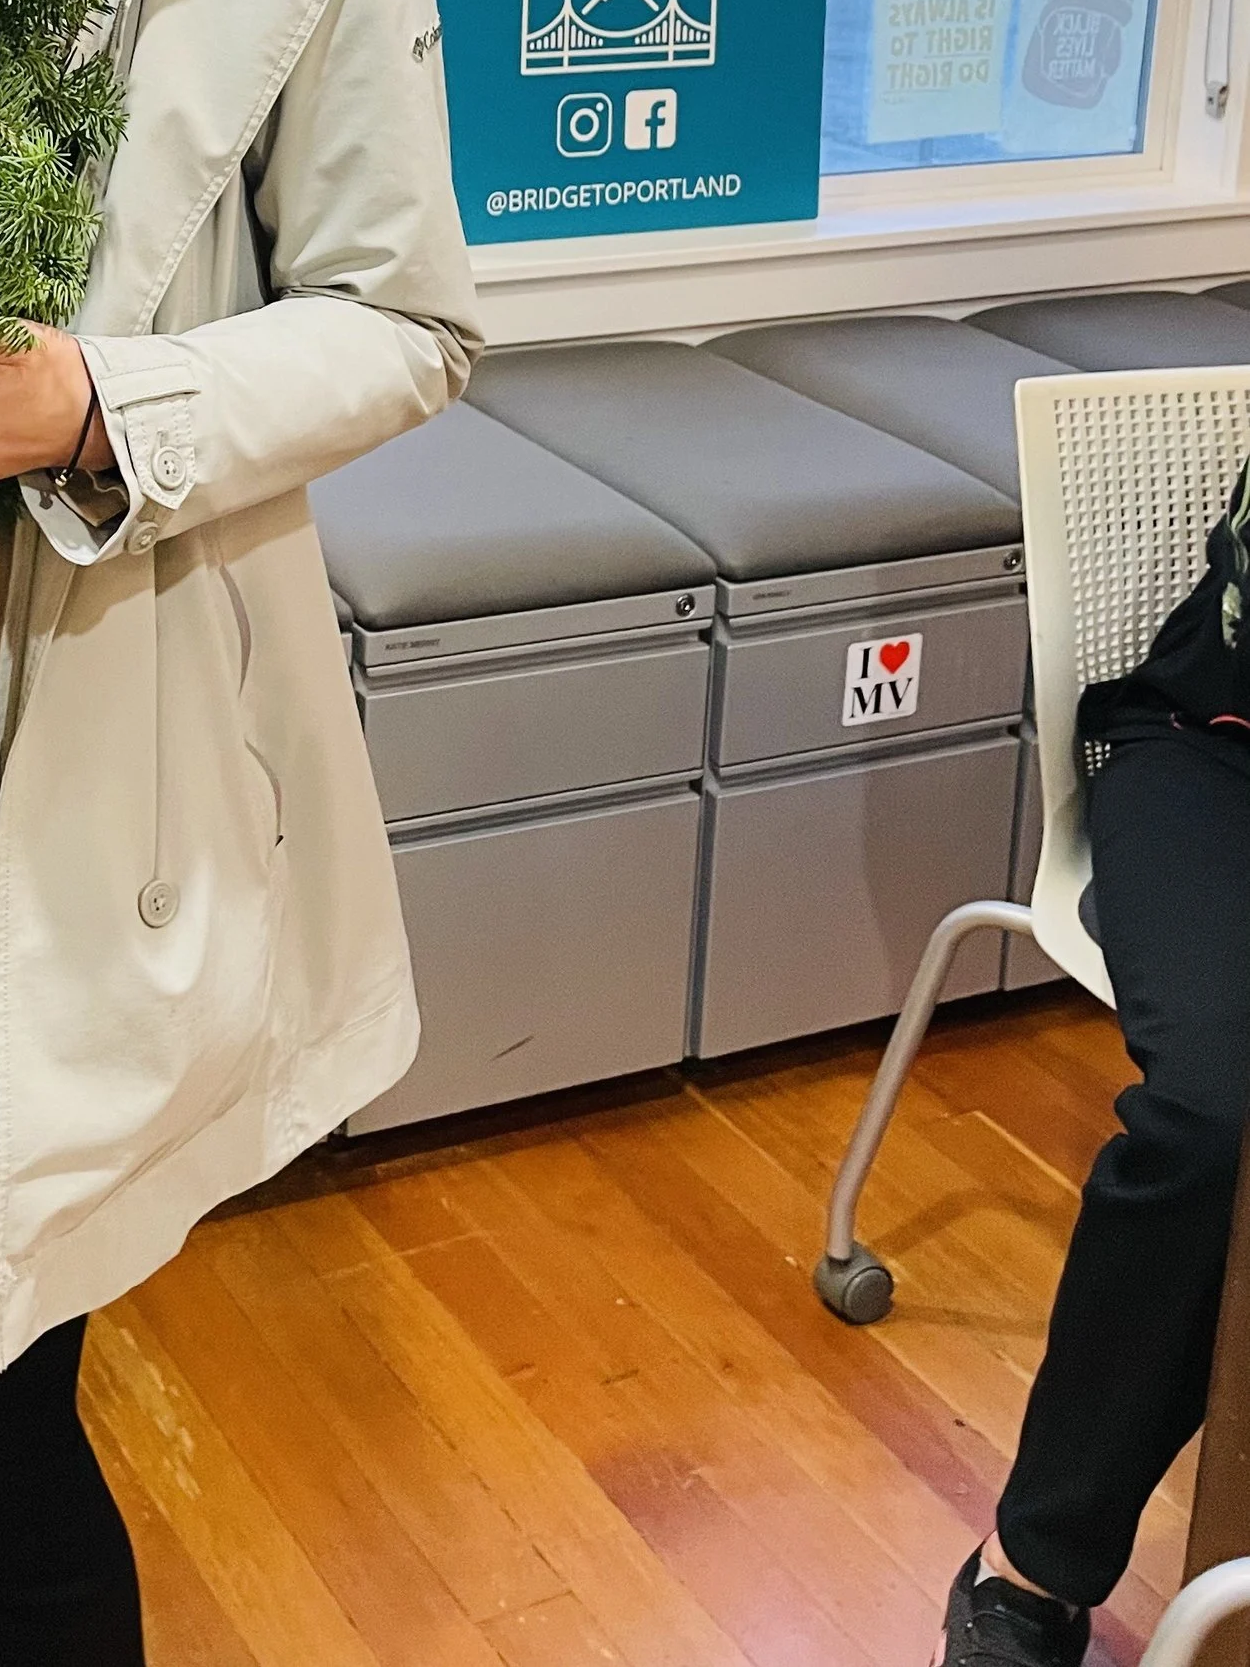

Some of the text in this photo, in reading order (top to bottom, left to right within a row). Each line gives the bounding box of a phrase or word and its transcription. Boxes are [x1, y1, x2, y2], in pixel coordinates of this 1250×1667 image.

[486, 174, 742, 216] @BRIDGETOPORTLAND
[858, 646, 873, 680] I
[848, 677, 913, 719] MV
